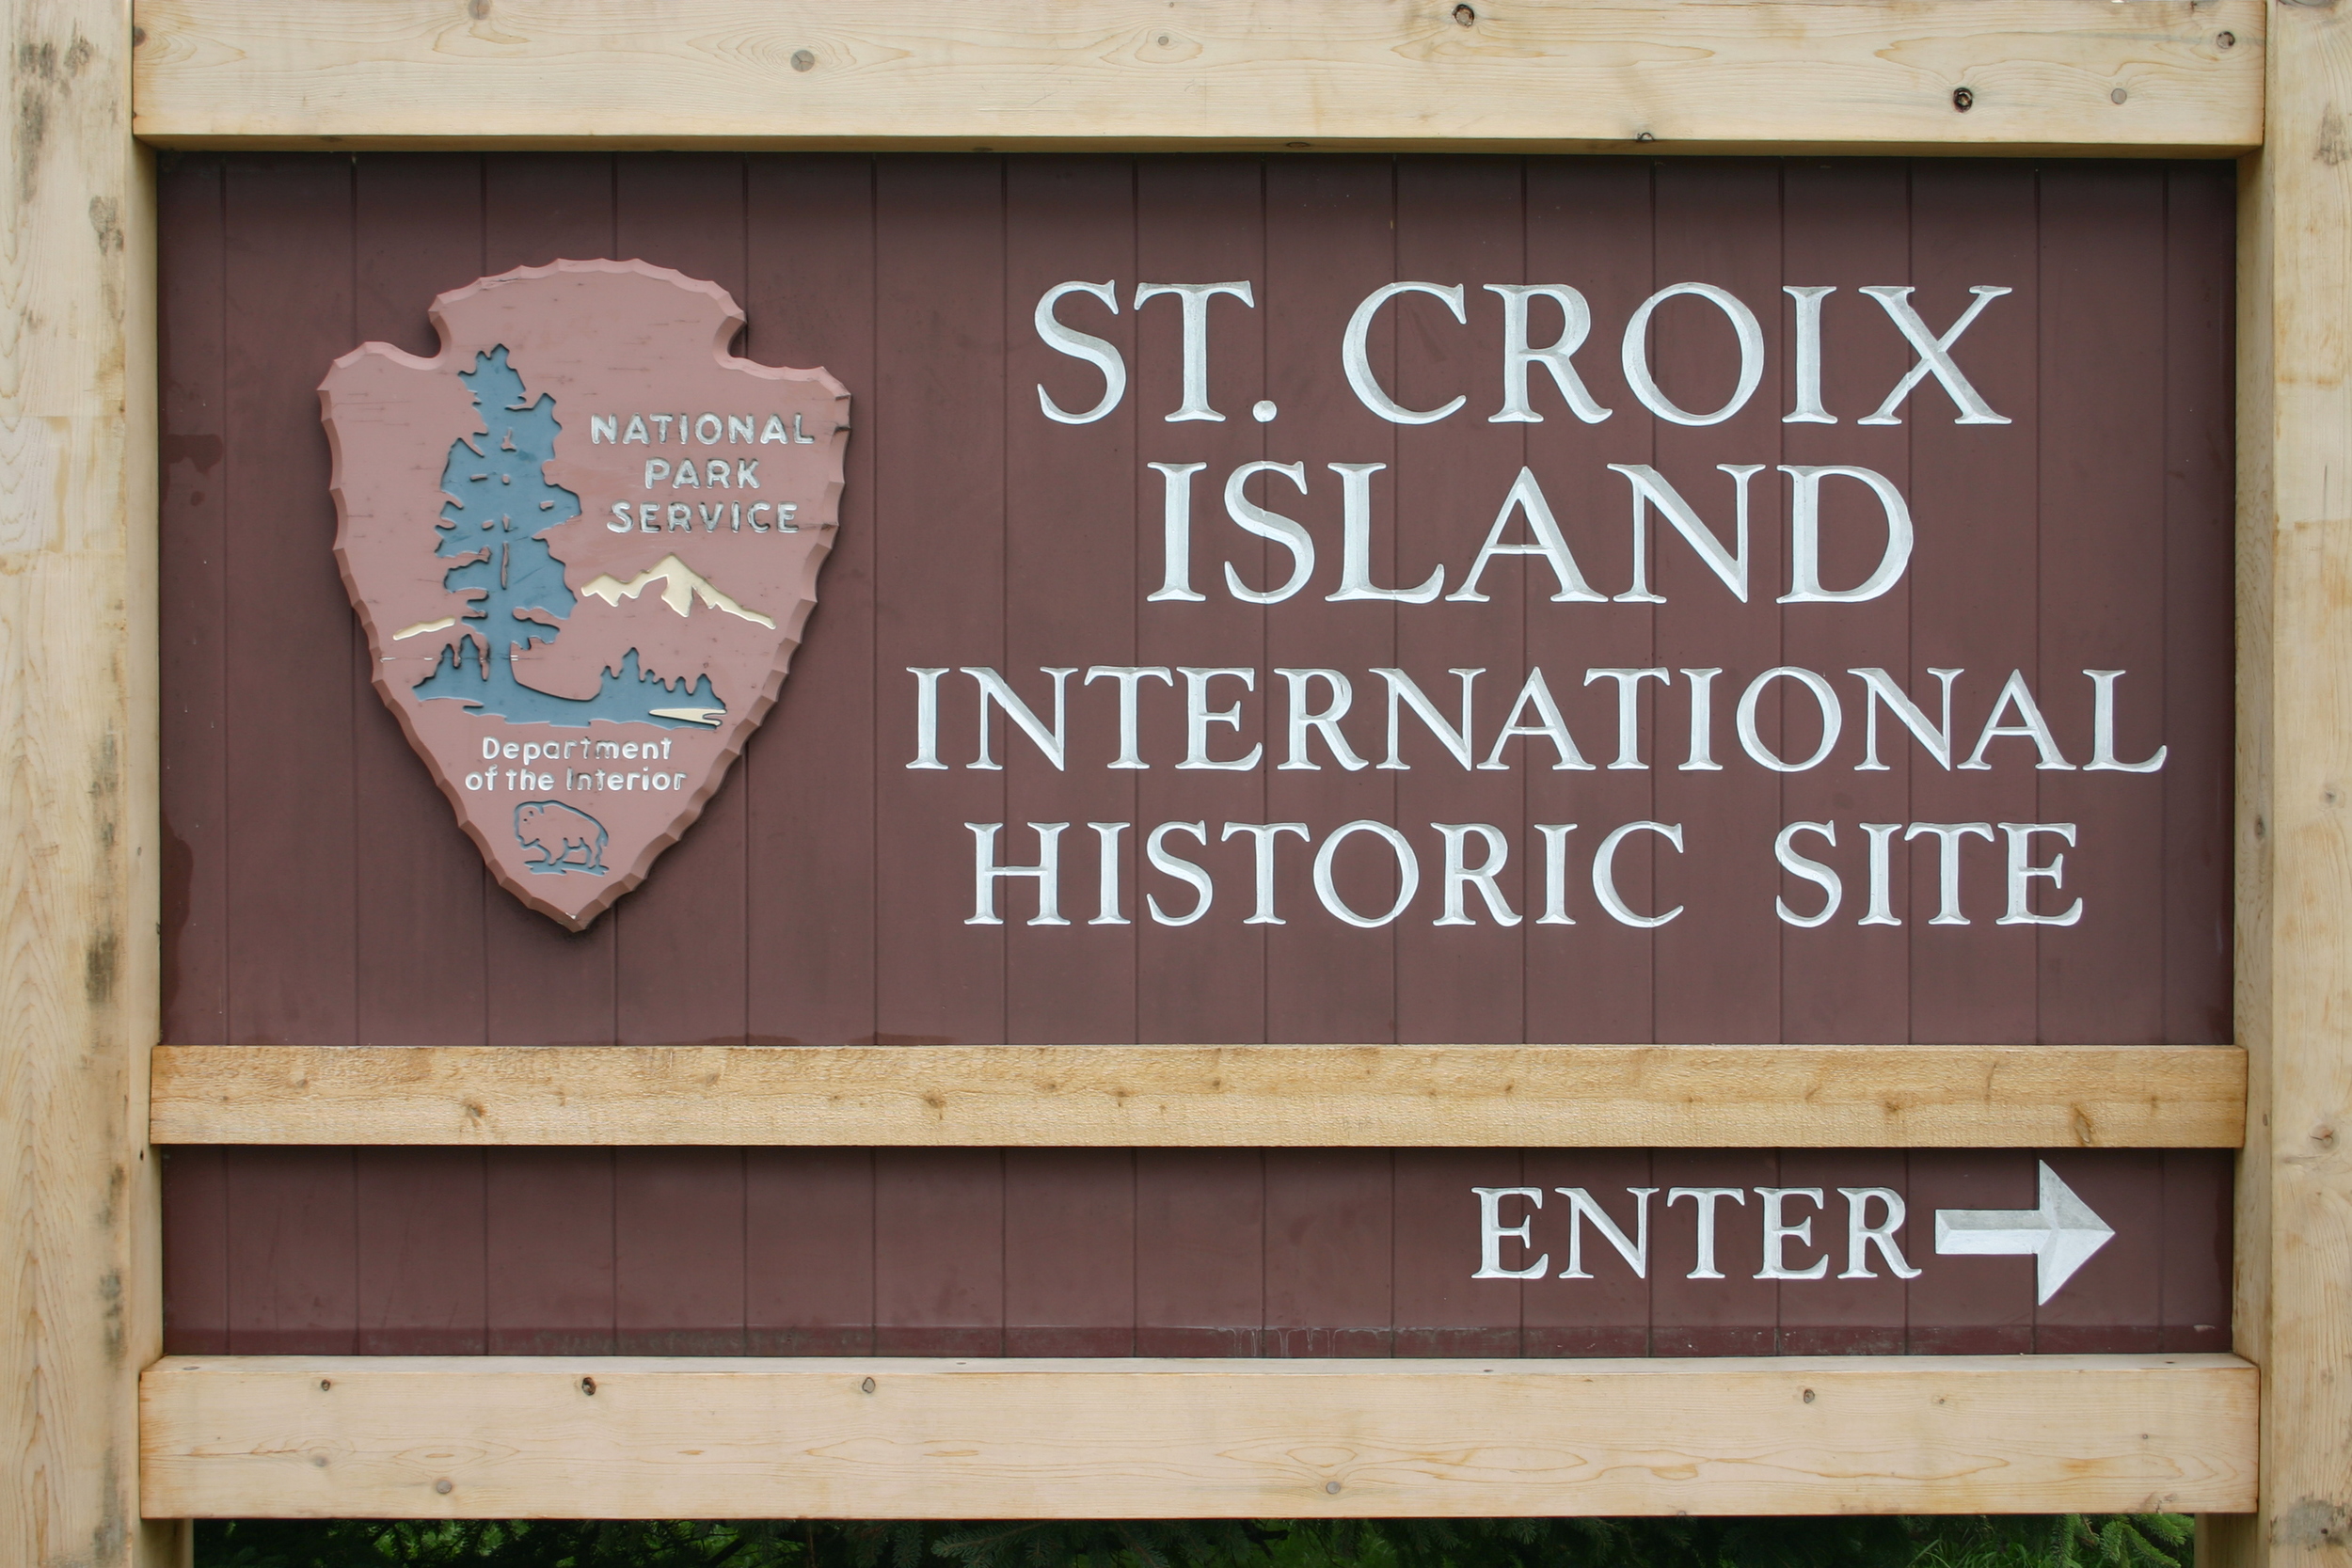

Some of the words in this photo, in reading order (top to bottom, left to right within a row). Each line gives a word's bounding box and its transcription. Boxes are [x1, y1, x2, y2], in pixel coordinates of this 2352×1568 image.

[1034, 279, 1278, 425] ST.
[1342, 281, 2013, 426] CROIX
[591, 412, 815, 445] NATIONAL
[644, 456, 760, 489] PARK
[607, 499, 799, 533] SERVICE
[1146, 460, 1915, 605] ISLAND
[483, 736, 672, 765] Department
[905, 665, 2169, 773] INTERNATIONAL
[465, 765, 498, 791] of
[506, 768, 555, 791] the
[566, 767, 687, 791] Interior
[963, 819, 1684, 928] HISTORIC
[1774, 819, 2084, 928] SITE
[1470, 1187, 1923, 1281] ENTER
